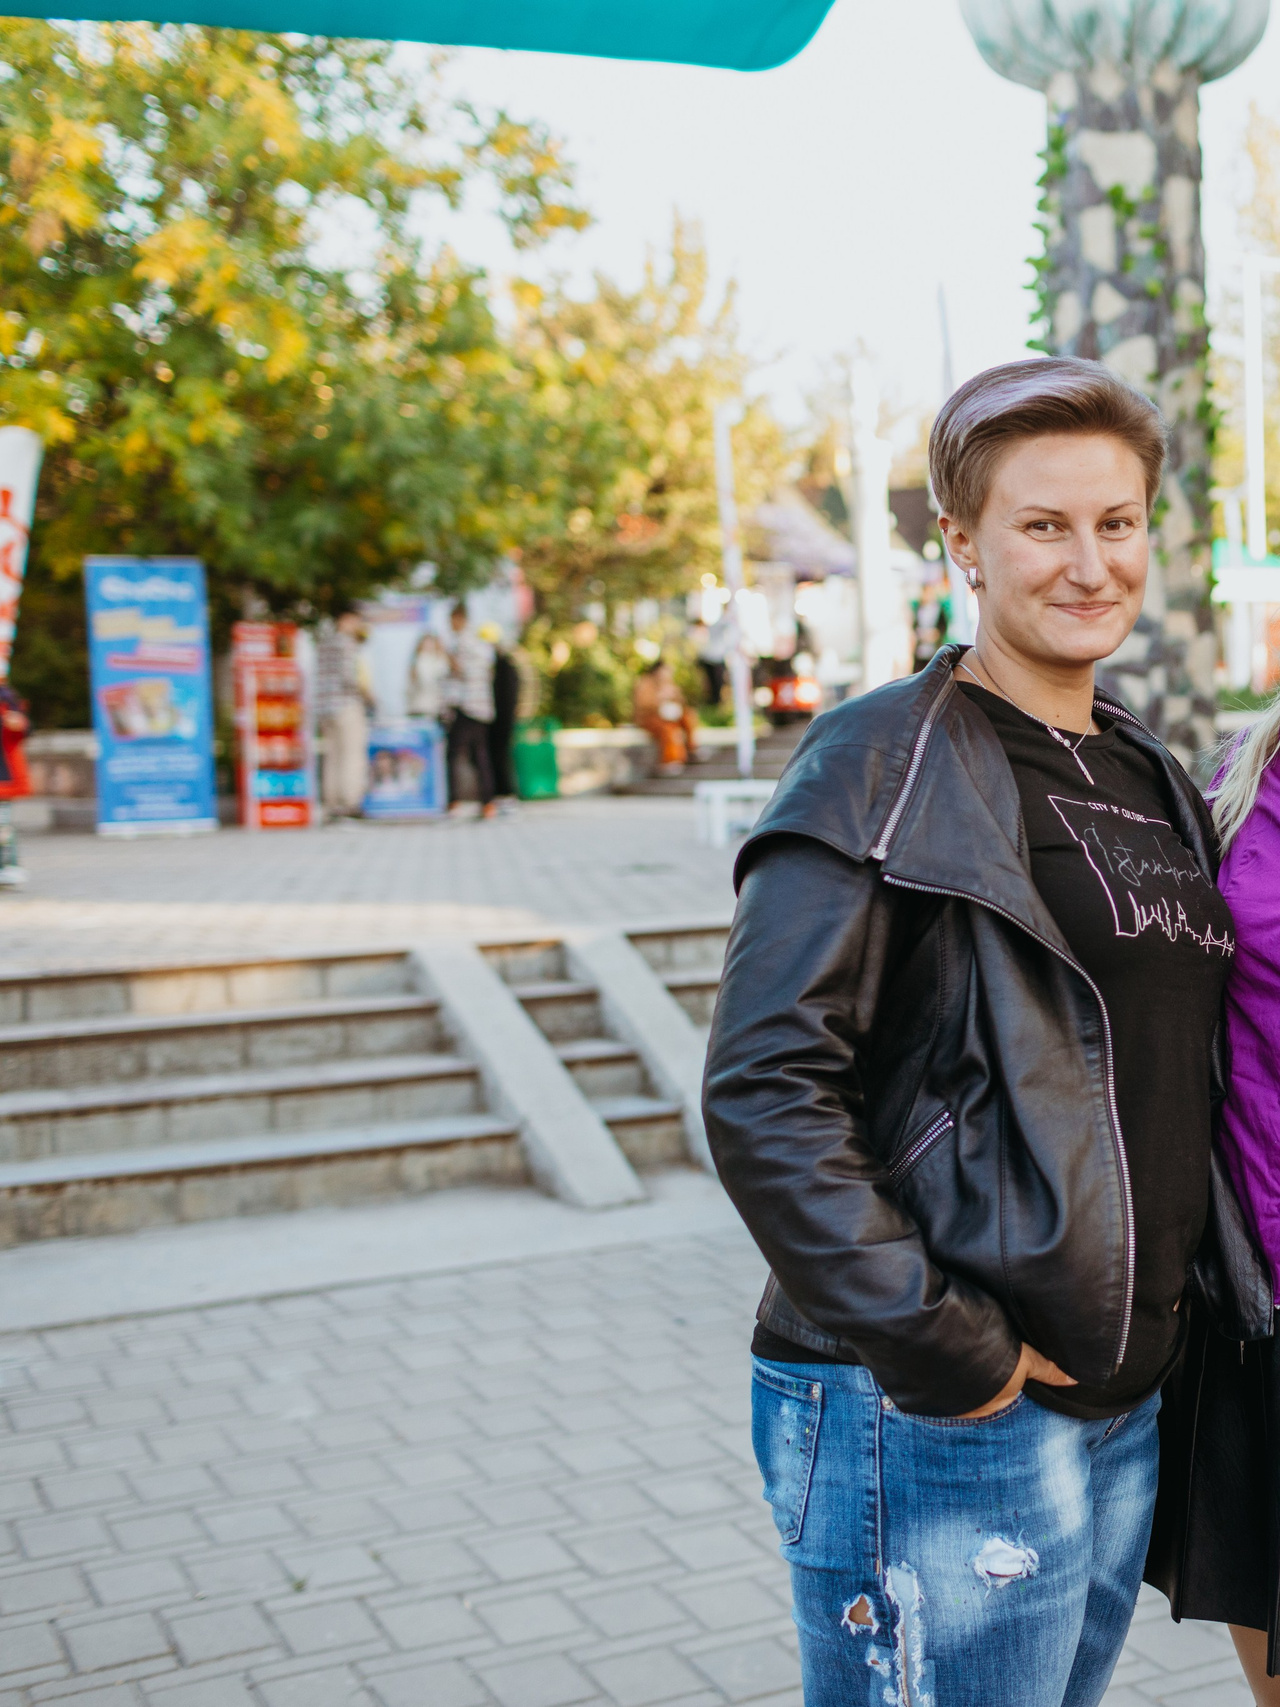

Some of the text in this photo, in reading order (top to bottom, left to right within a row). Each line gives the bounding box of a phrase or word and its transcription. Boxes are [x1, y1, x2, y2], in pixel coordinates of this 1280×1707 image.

[1087, 801, 1148, 823] CITY OF CULTURE
